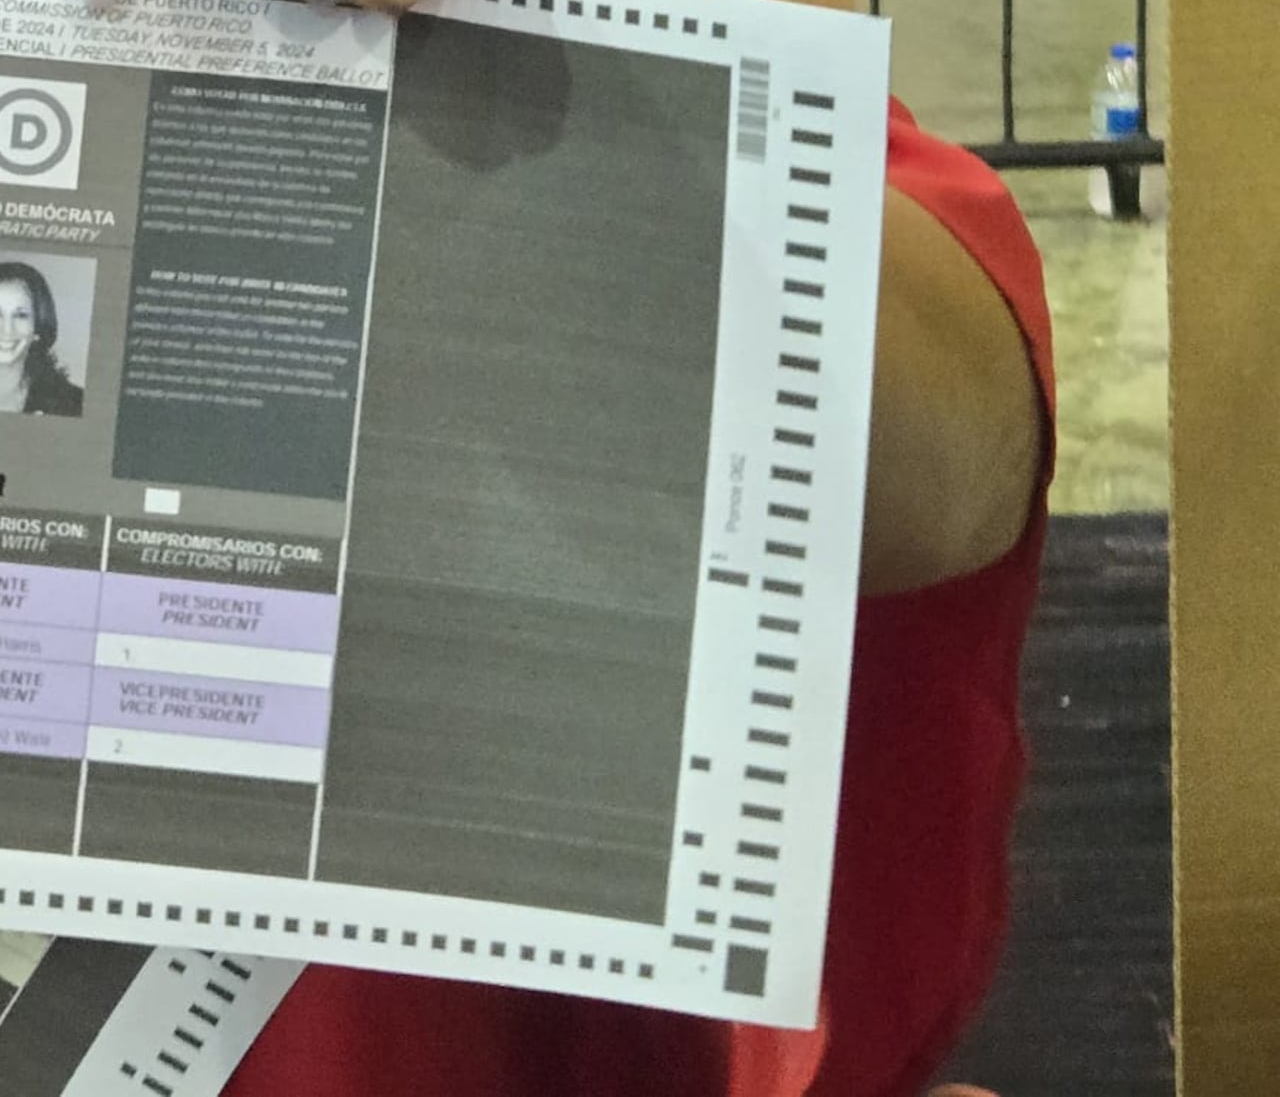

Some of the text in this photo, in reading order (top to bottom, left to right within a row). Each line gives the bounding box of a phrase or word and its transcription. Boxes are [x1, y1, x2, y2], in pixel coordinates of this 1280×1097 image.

[218, 0, 258, 15] RICO
[108, 9, 129, 22] OF
[135, 13, 208, 30] PUERTO
[208, 17, 252, 33] RICO
[17, 20, 54, 37] 2024
[158, 34, 253, 53] NOVEMBER
[276, 43, 315, 58] 2024
[70, 44, 192, 67] PRESIDENTIAL
[197, 54, 312, 78] PREFERENCE
[317, 69, 384, 85] BALLOT
[10, 113, 48, 150] D
[5, 203, 115, 226] DEMÓCRATA
[45, 226, 101, 243] PARTY
[45, 521, 88, 539] CON:
[117, 527, 323, 563] COMPROMISARIOS CON:
[141, 547, 231, 572] ELECTORS
[159, 592, 264, 616] PRESIDENTE
[162, 609, 260, 631] PRESIDENT
[120, 681, 265, 709] VICEPRESIDENTE
[120, 698, 260, 725] VICE PRESIDENT
